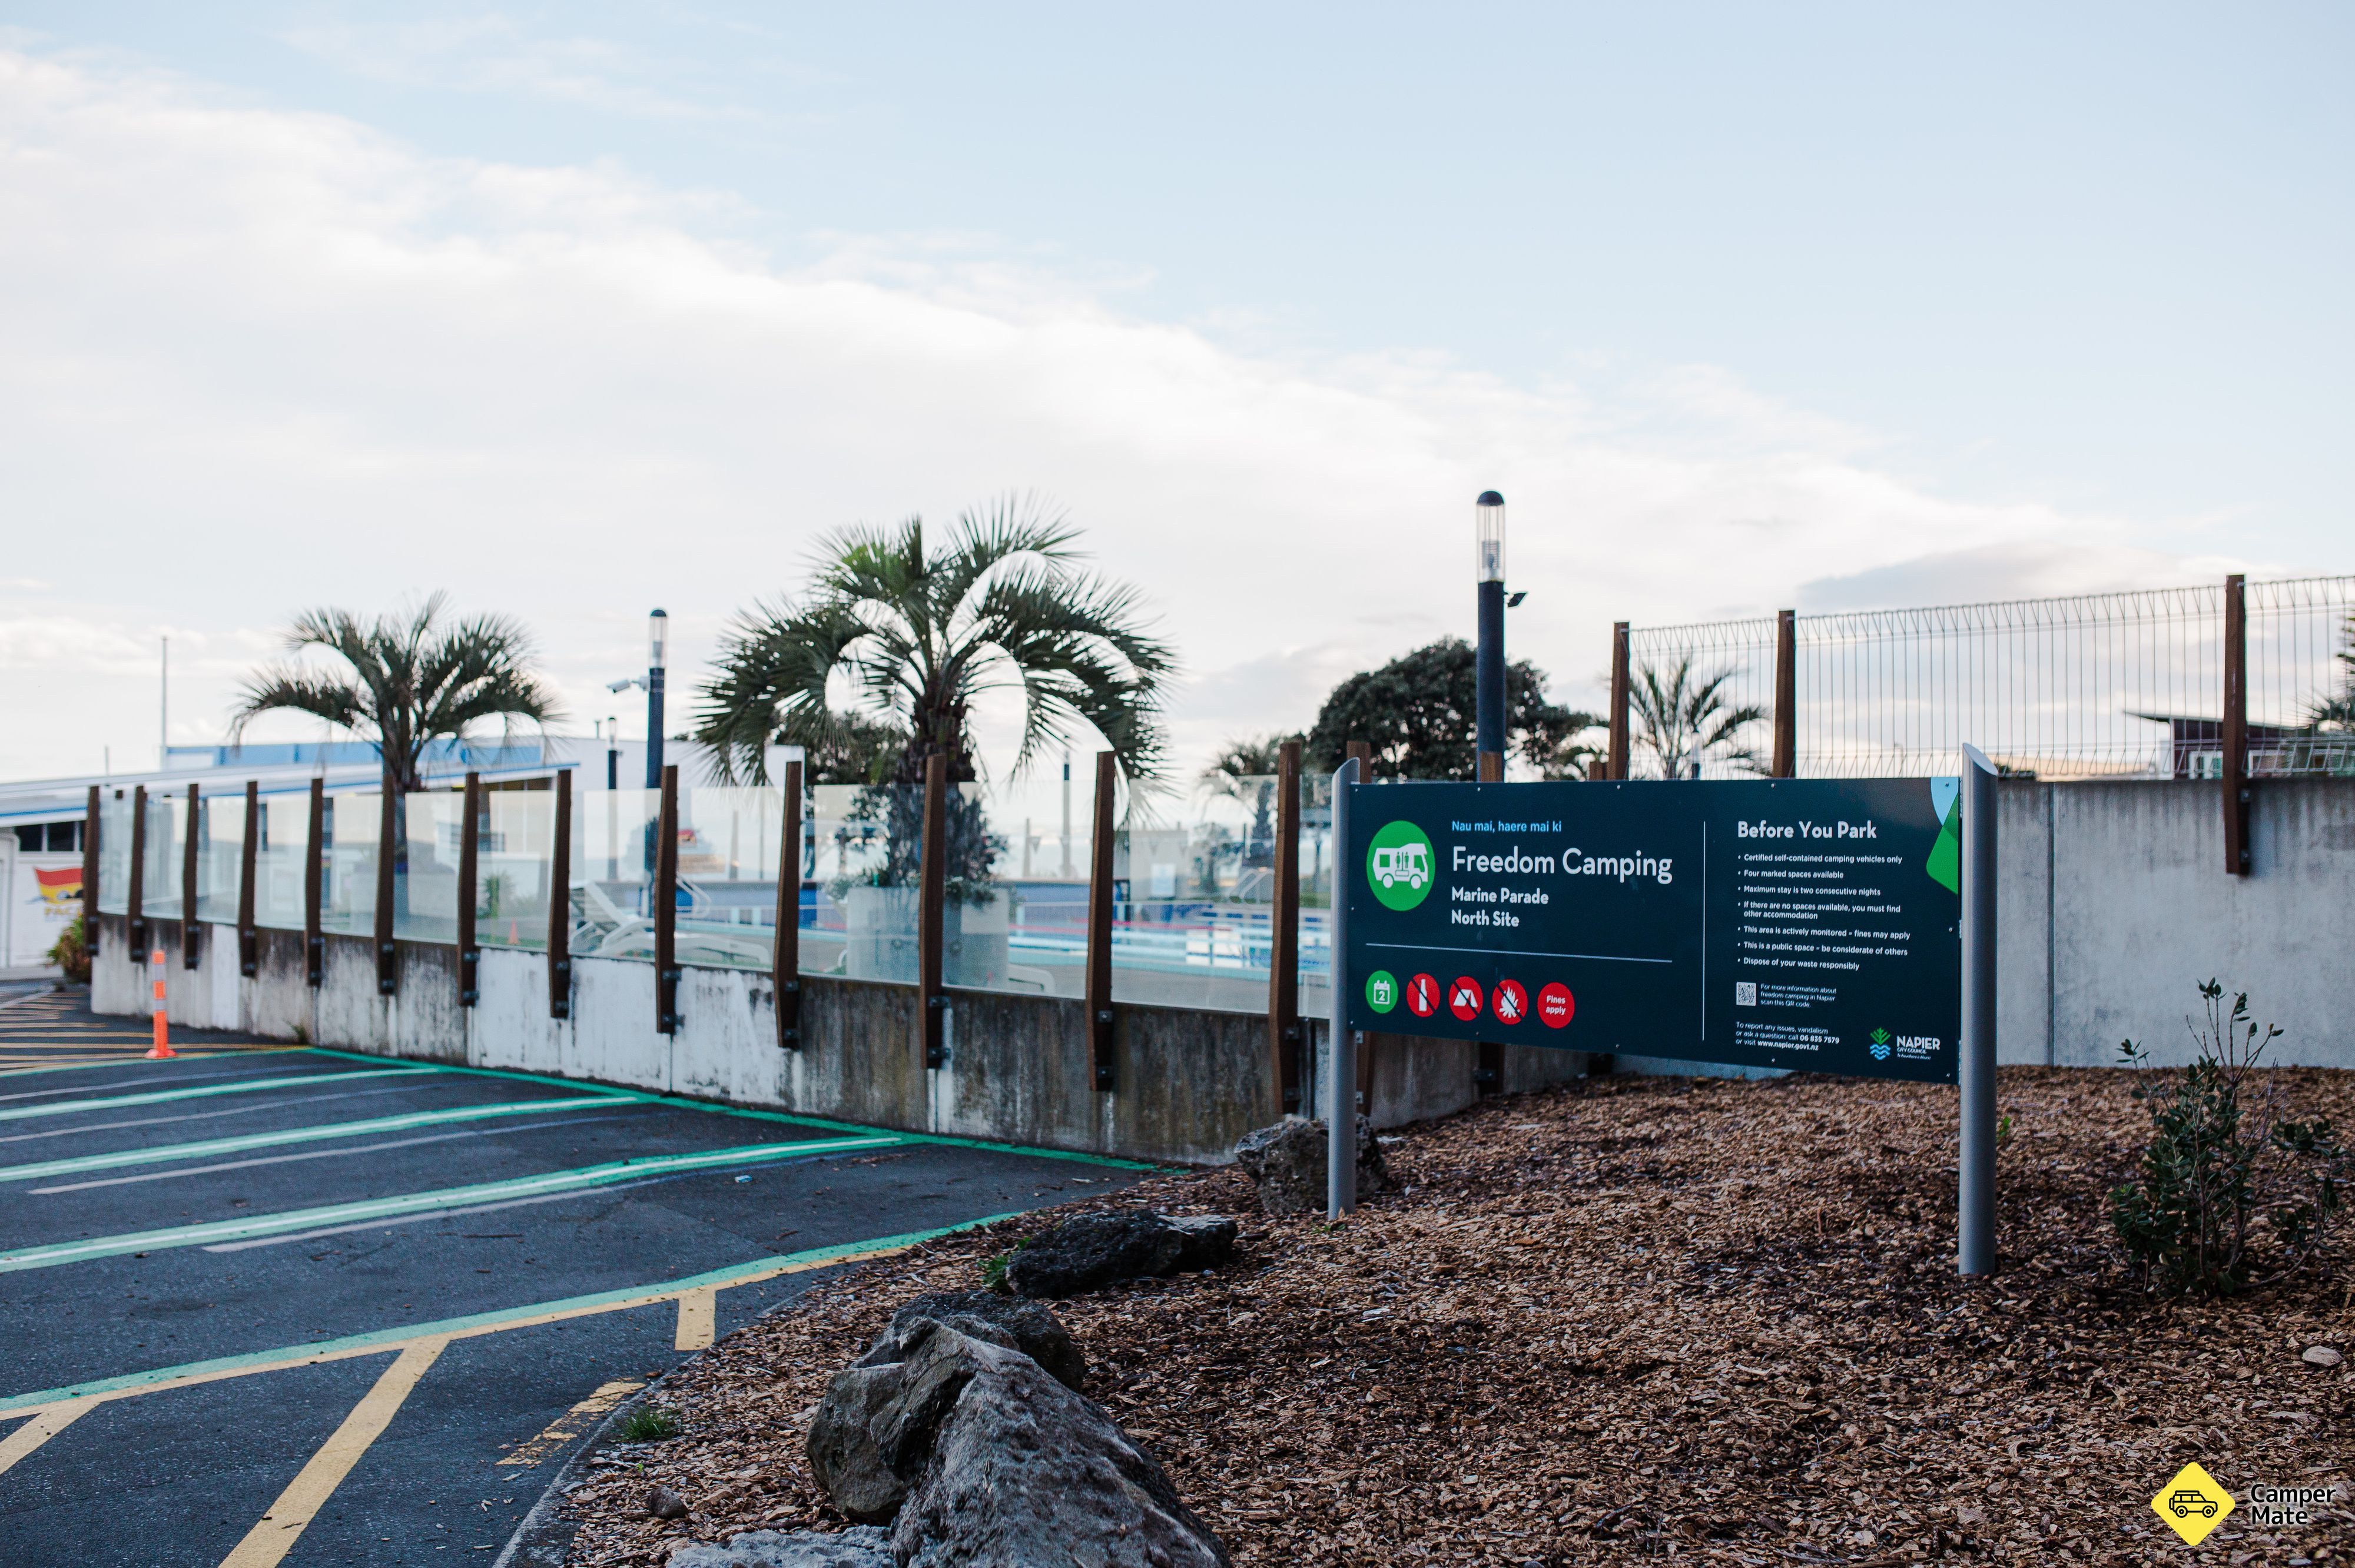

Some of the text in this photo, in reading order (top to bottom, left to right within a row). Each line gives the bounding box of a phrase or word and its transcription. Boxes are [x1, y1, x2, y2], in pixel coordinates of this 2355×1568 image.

[1452, 820, 1562, 833] Nau mai, haere mai ki
[1738, 820, 1877, 839] Before You Park
[1452, 845, 1673, 885] Freedom Camping
[1744, 853, 1902, 865] Certified self-contained camping vehicles only
[1813, 871, 1844, 879] available
[1451, 886, 1549, 905] Marine Parade
[1777, 886, 1792, 895] stay
[1793, 886, 1799, 894] is
[1859, 888, 1880, 897] nights
[1817, 903, 1850, 912] available,
[1886, 905, 1901, 913] find
[1451, 909, 1520, 927] North Site
[1743, 925, 1757, 934] This
[1782, 927, 1809, 936] actively
[1810, 929, 1847, 937] monitored
[1854, 929, 1872, 938] fines
[1873, 931, 1889, 940] may
[1890, 932, 1910, 941] apply
[1743, 941, 1757, 949] This
[1772, 942, 1793, 951] public
[1821, 945, 1831, 953] be
[1832, 945, 1874, 955] considerate
[1875, 947, 1883, 955] of
[1885, 948, 1908, 956] others
[1743, 956, 1860, 971] Dispose of your waste responsibly
[1787, 985, 1819, 994] information
[1378, 991, 1385, 1001] 2
[1545, 995, 1566, 1004] Fines
[1545, 1006, 1566, 1016] apply
[1745, 1023, 1764, 1031] report
[1777, 1025, 1797, 1034] issues,
[1797, 1026, 1829, 1035] vandalism
[1757, 1041, 1820, 1052] www.napier.govt.nz
[1896, 1035, 1941, 1051] NAPIER
